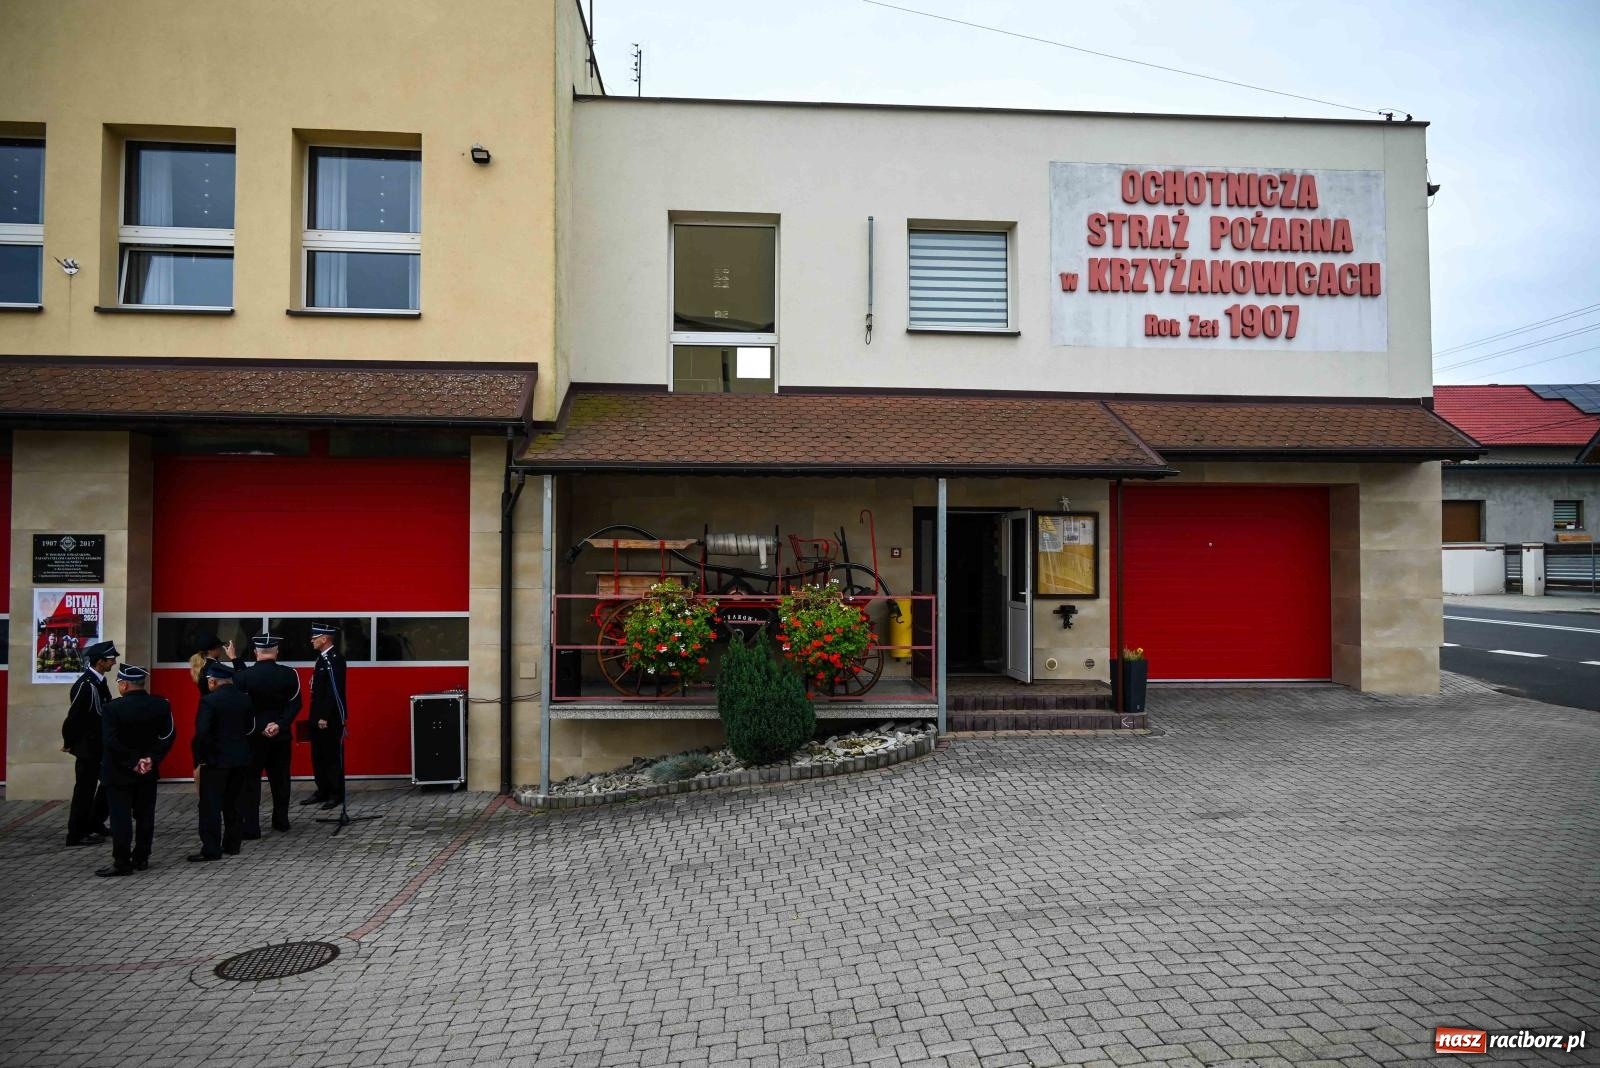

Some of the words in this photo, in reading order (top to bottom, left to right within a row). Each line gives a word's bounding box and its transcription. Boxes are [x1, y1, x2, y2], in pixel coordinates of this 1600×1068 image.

[1121, 169, 1319, 209] OCHOTNICZA
[1086, 208, 1190, 249] STRAŻ
[1209, 210, 1354, 252] POŻARNA
[1087, 252, 1382, 297] KRZYŻANOWICACH
[1144, 314, 1181, 337] Rok
[1188, 314, 1220, 338] Zał
[1224, 303, 1300, 340] 1907
[65, 595, 98, 608] BITWA
